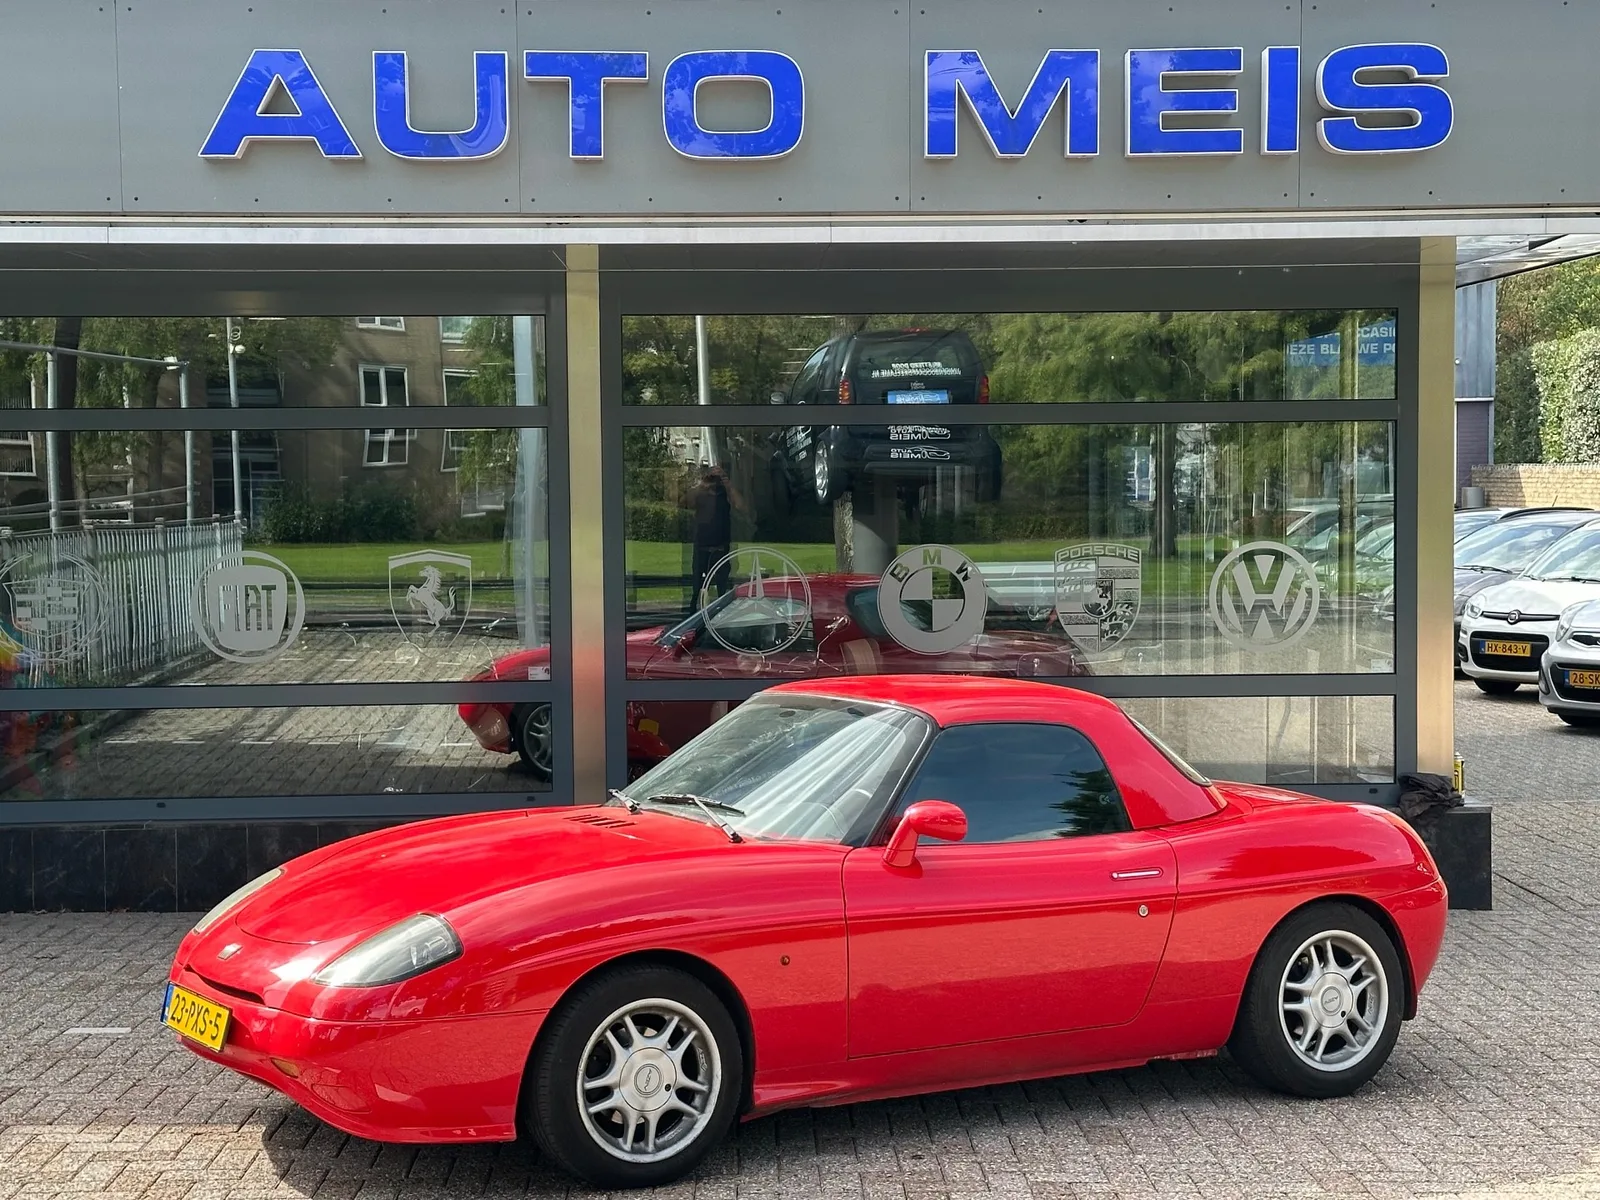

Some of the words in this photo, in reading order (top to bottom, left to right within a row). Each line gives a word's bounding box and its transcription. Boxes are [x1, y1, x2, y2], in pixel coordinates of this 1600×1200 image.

[198, 49, 806, 162] AUTO
[923, 42, 1455, 160] MEIS
[889, 548, 972, 583] BMW
[1057, 545, 1139, 562] PORSCHE
[218, 584, 277, 632] FIAT
[1487, 643, 1527, 654] HX-843-V
[170, 993, 222, 1041] 23-PXS-5
